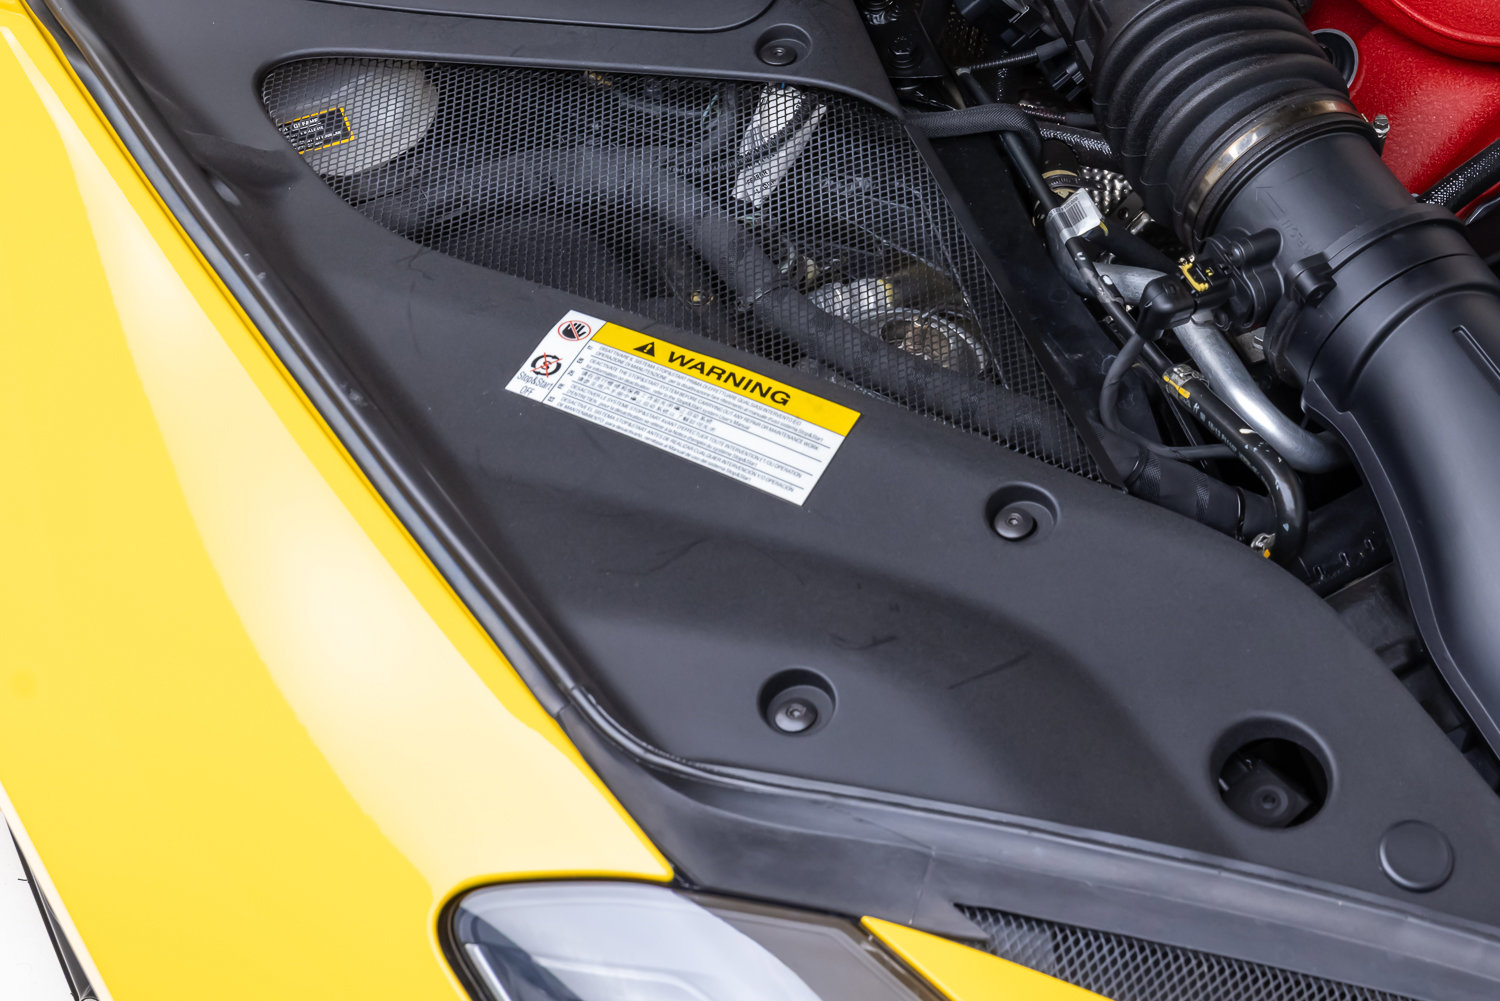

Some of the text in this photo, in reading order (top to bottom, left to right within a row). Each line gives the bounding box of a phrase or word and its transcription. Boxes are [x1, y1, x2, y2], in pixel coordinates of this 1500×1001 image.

[515, 370, 554, 391] Stop&Start
[663, 350, 794, 406] WARNING
[518, 385, 535, 396] OFF
